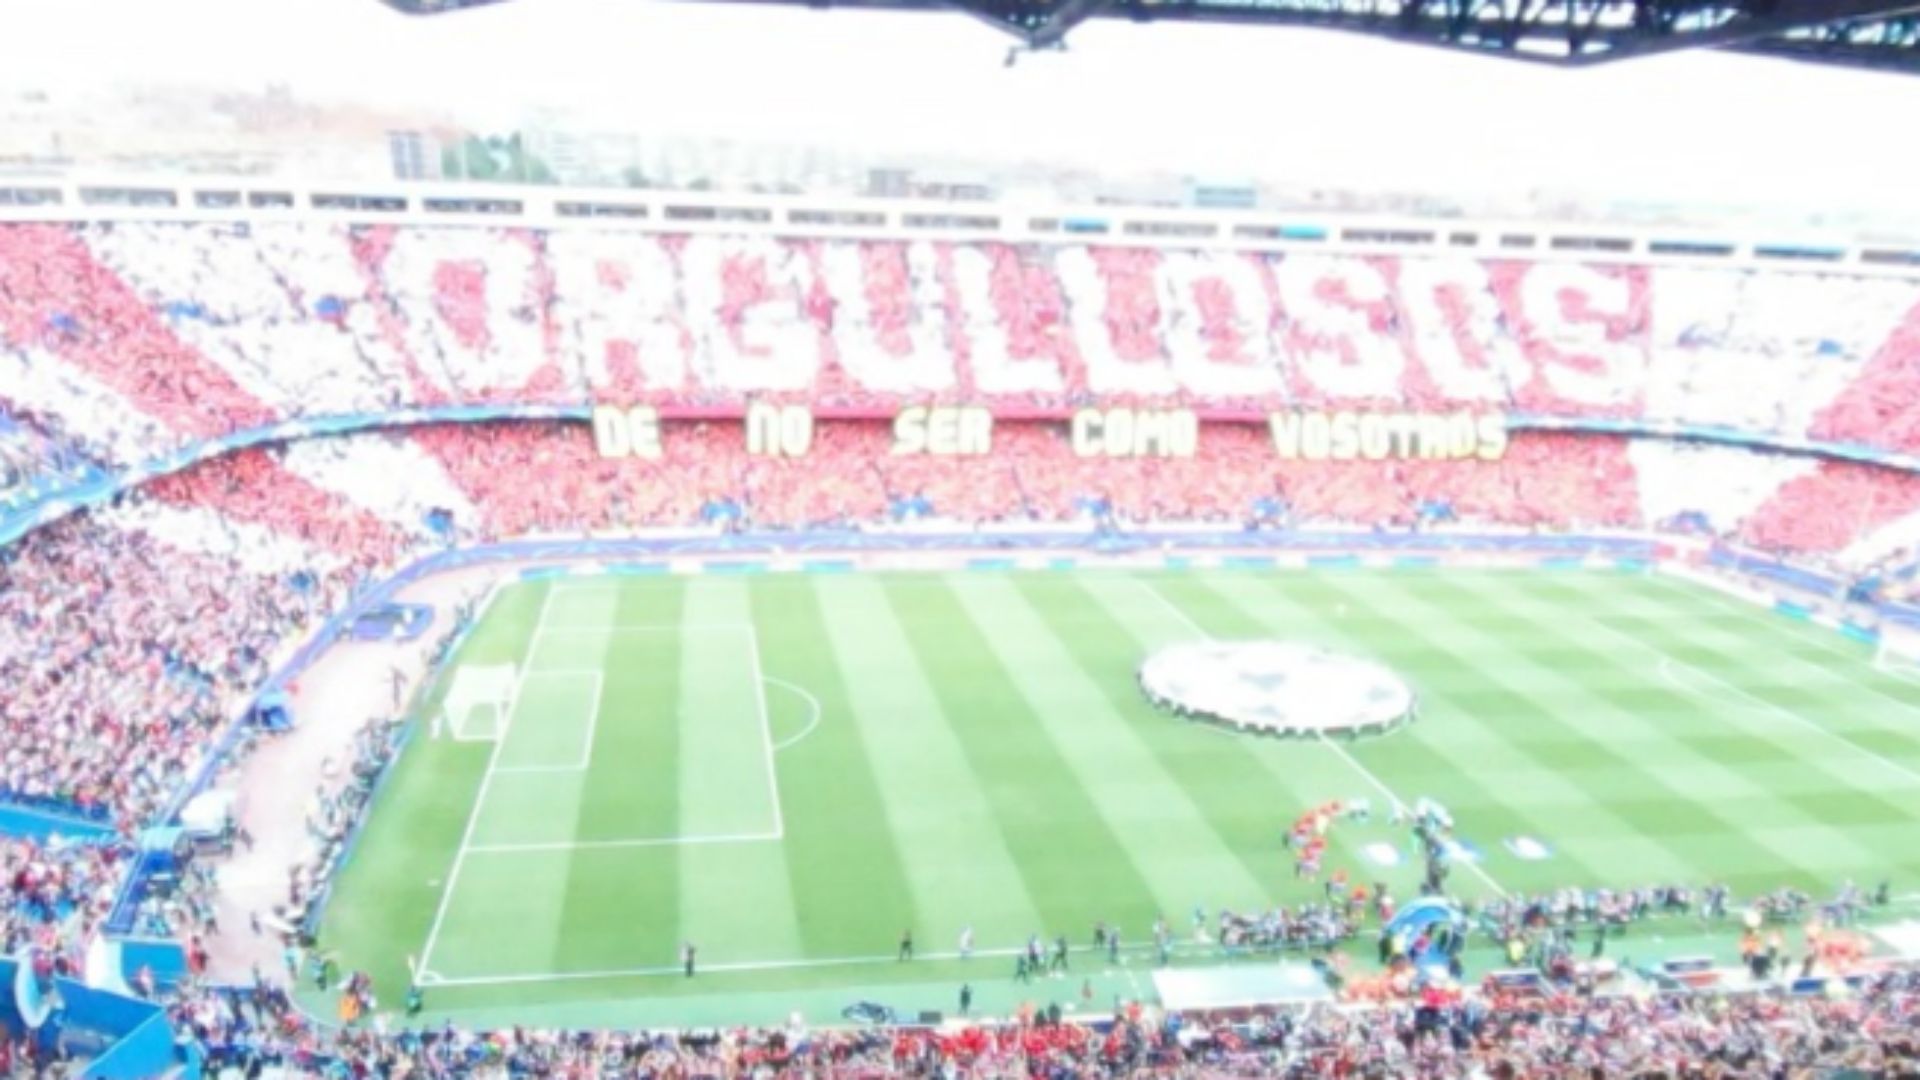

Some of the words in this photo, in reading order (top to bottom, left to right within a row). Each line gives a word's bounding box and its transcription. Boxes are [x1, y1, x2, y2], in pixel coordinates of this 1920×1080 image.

[386, 231, 1646, 400] ORGULLOSOS
[593, 404, 662, 459] DE
[746, 402, 813, 457] NO
[893, 405, 992, 455] SER
[1072, 407, 1197, 457] COMO
[1269, 409, 1507, 460] VOSOTROS
